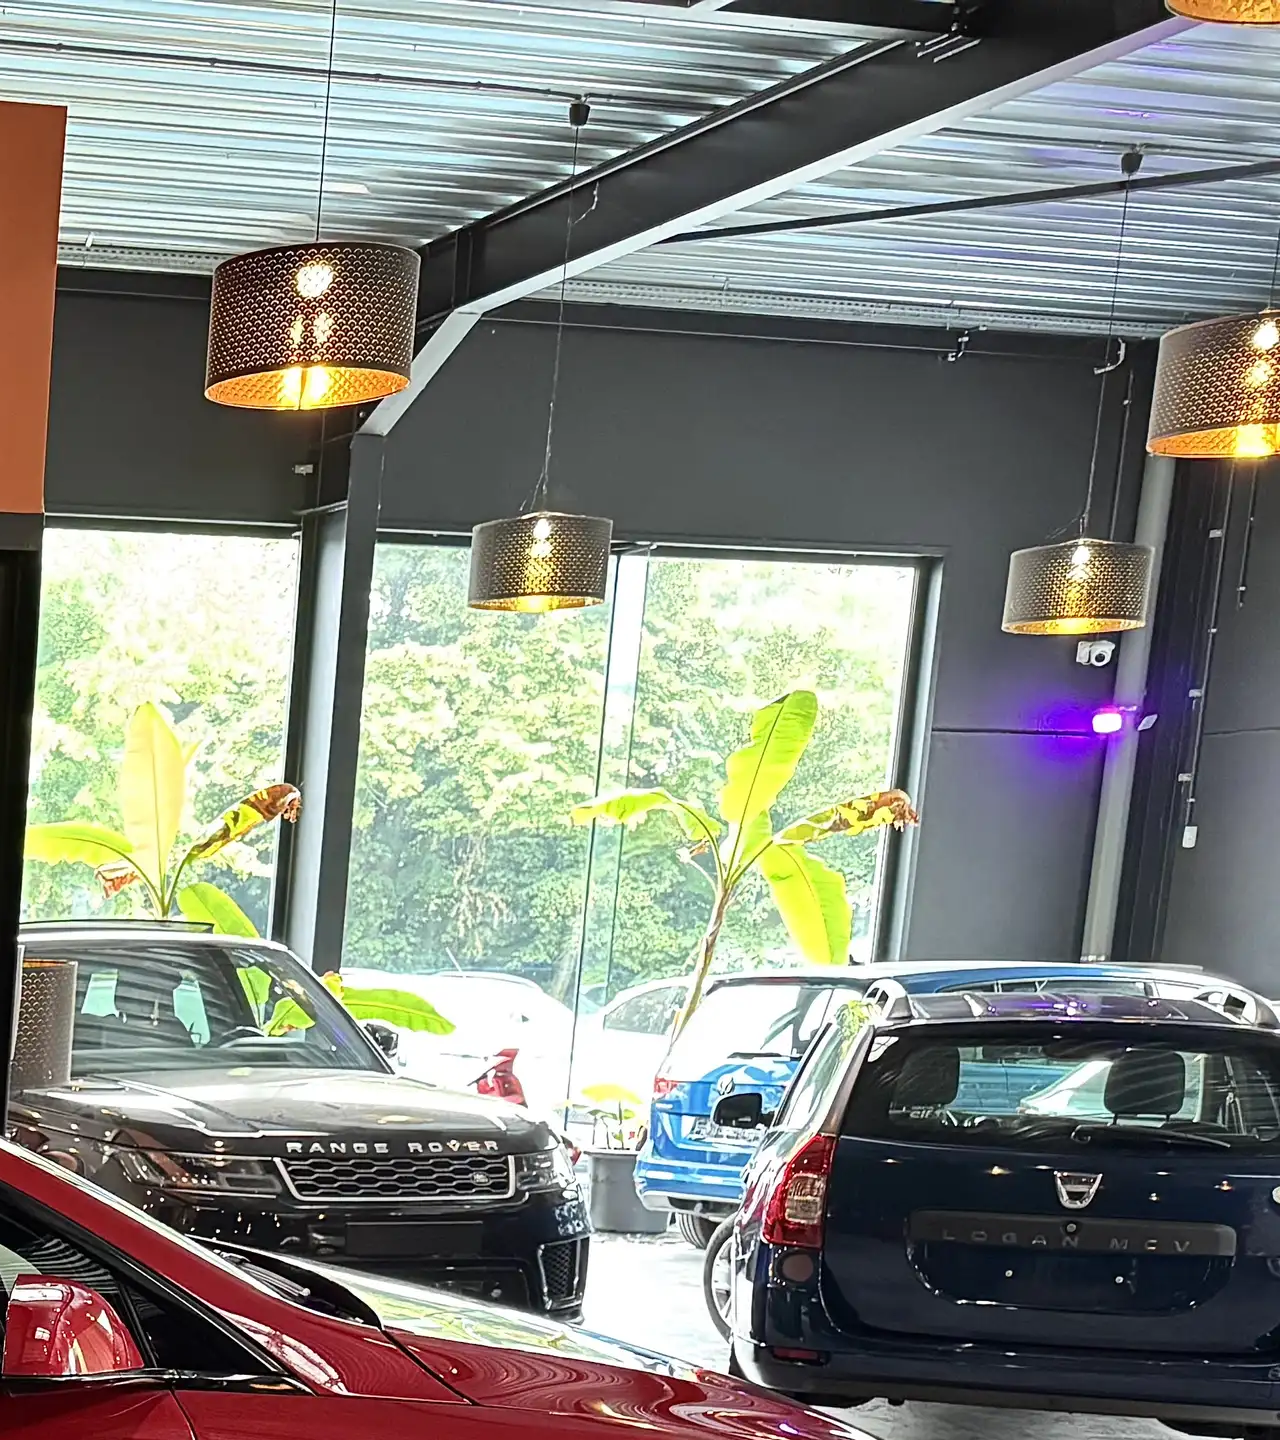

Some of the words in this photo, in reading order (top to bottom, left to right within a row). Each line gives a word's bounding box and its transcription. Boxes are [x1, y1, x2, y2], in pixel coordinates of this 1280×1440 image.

[286, 1141, 389, 1154] RANGE
[407, 1139, 500, 1153] ROVER
[942, 1230, 1080, 1249] LOGAN
[1108, 1237, 1191, 1253] MCV
